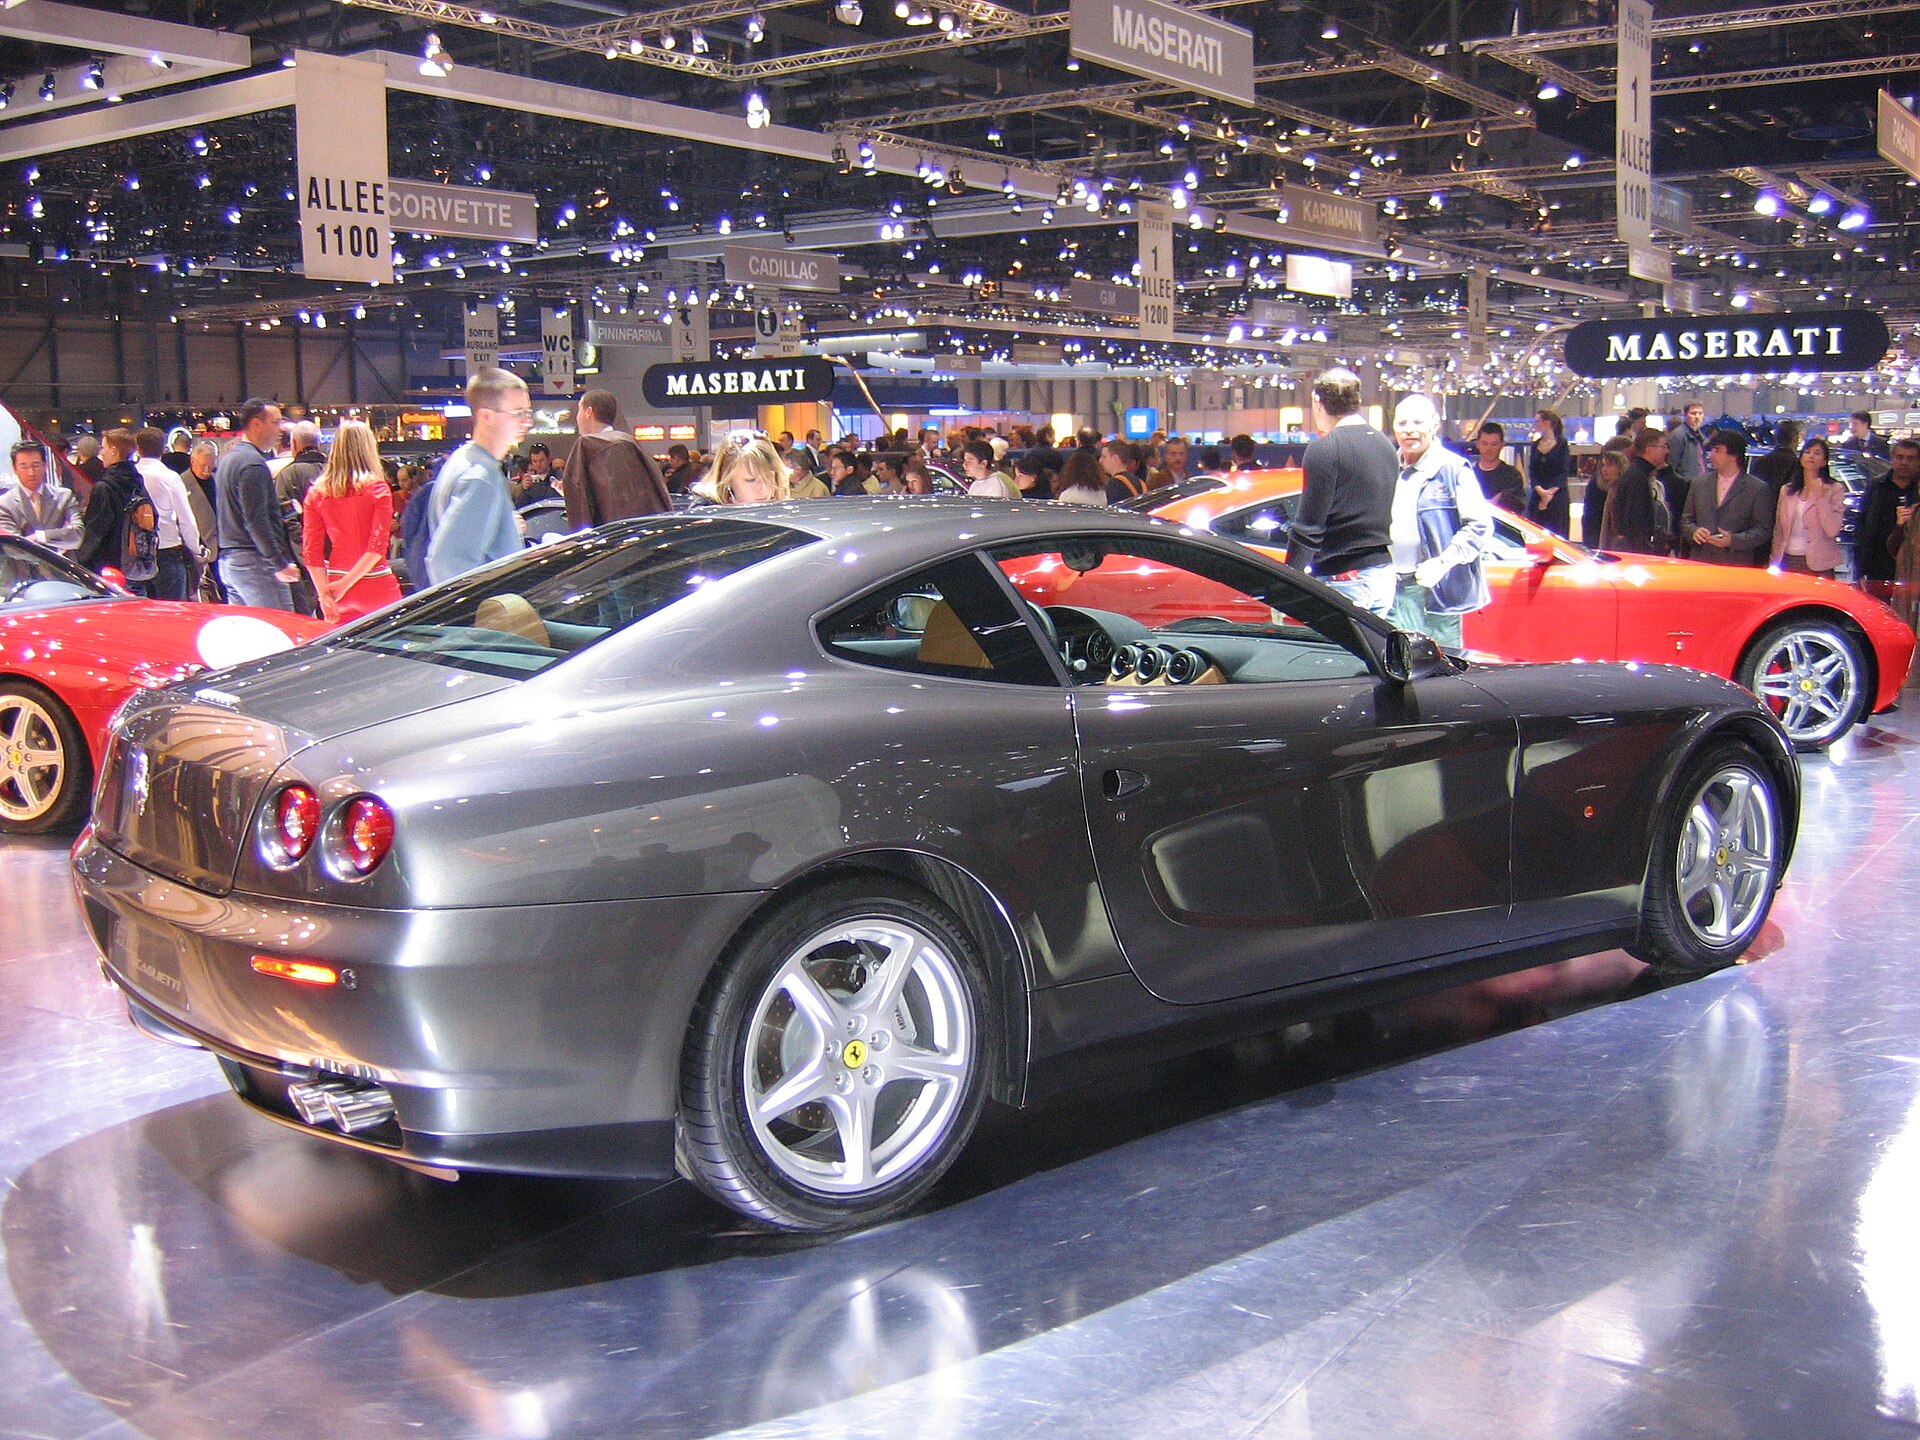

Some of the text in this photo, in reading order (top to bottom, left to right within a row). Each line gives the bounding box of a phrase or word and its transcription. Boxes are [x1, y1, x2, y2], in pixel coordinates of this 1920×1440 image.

[1112, 4, 1224, 77] MASERATI
[1631, 76, 1638, 123] 1
[1620, 128, 1650, 175] ALLEE
[307, 176, 385, 216] ALLEE
[389, 190, 513, 228] CORVETTE
[1623, 180, 1648, 222] 1100
[1303, 200, 1363, 232] KARMANN
[316, 223, 379, 259] 1100
[749, 256, 819, 280] CADILLAC
[1151, 245, 1159, 272] 1
[1141, 278, 1172, 299] ALLEE
[1143, 303, 1169, 325] 1200
[468, 328, 494, 338] SORTIE
[543, 334, 570, 352] WC
[598, 326, 664, 343] PININFARINA
[1605, 326, 1843, 363] MASERATI
[474, 353, 490, 363] EXIT
[666, 368, 807, 396] MASERATI
